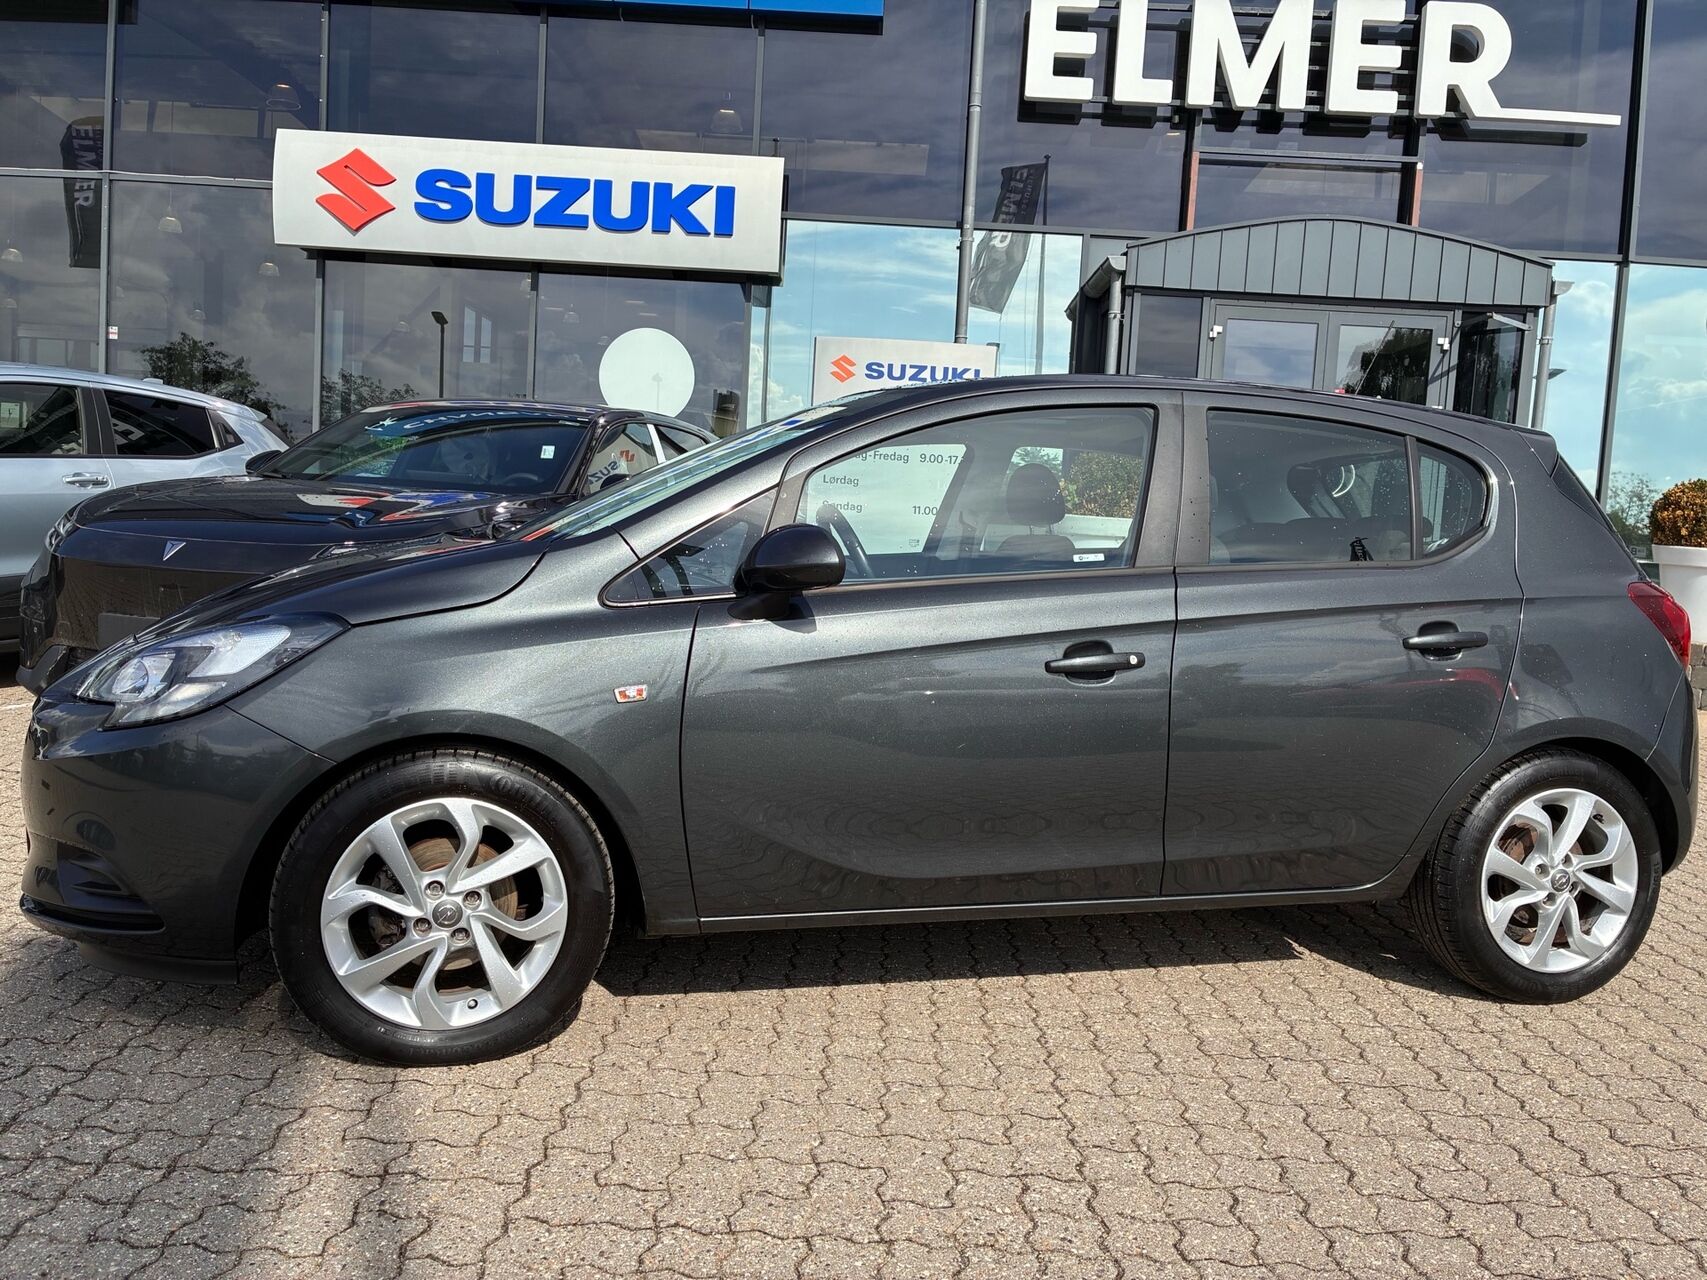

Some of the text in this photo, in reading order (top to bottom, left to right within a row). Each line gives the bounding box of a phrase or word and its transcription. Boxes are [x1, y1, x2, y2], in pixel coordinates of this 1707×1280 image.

[1023, 0, 1622, 126] ELMER
[71, 124, 97, 208] ELMER
[414, 168, 736, 238] SUZUKI
[864, 361, 981, 382] SUZUKI
[822, 474, 860, 487] Lørdag
